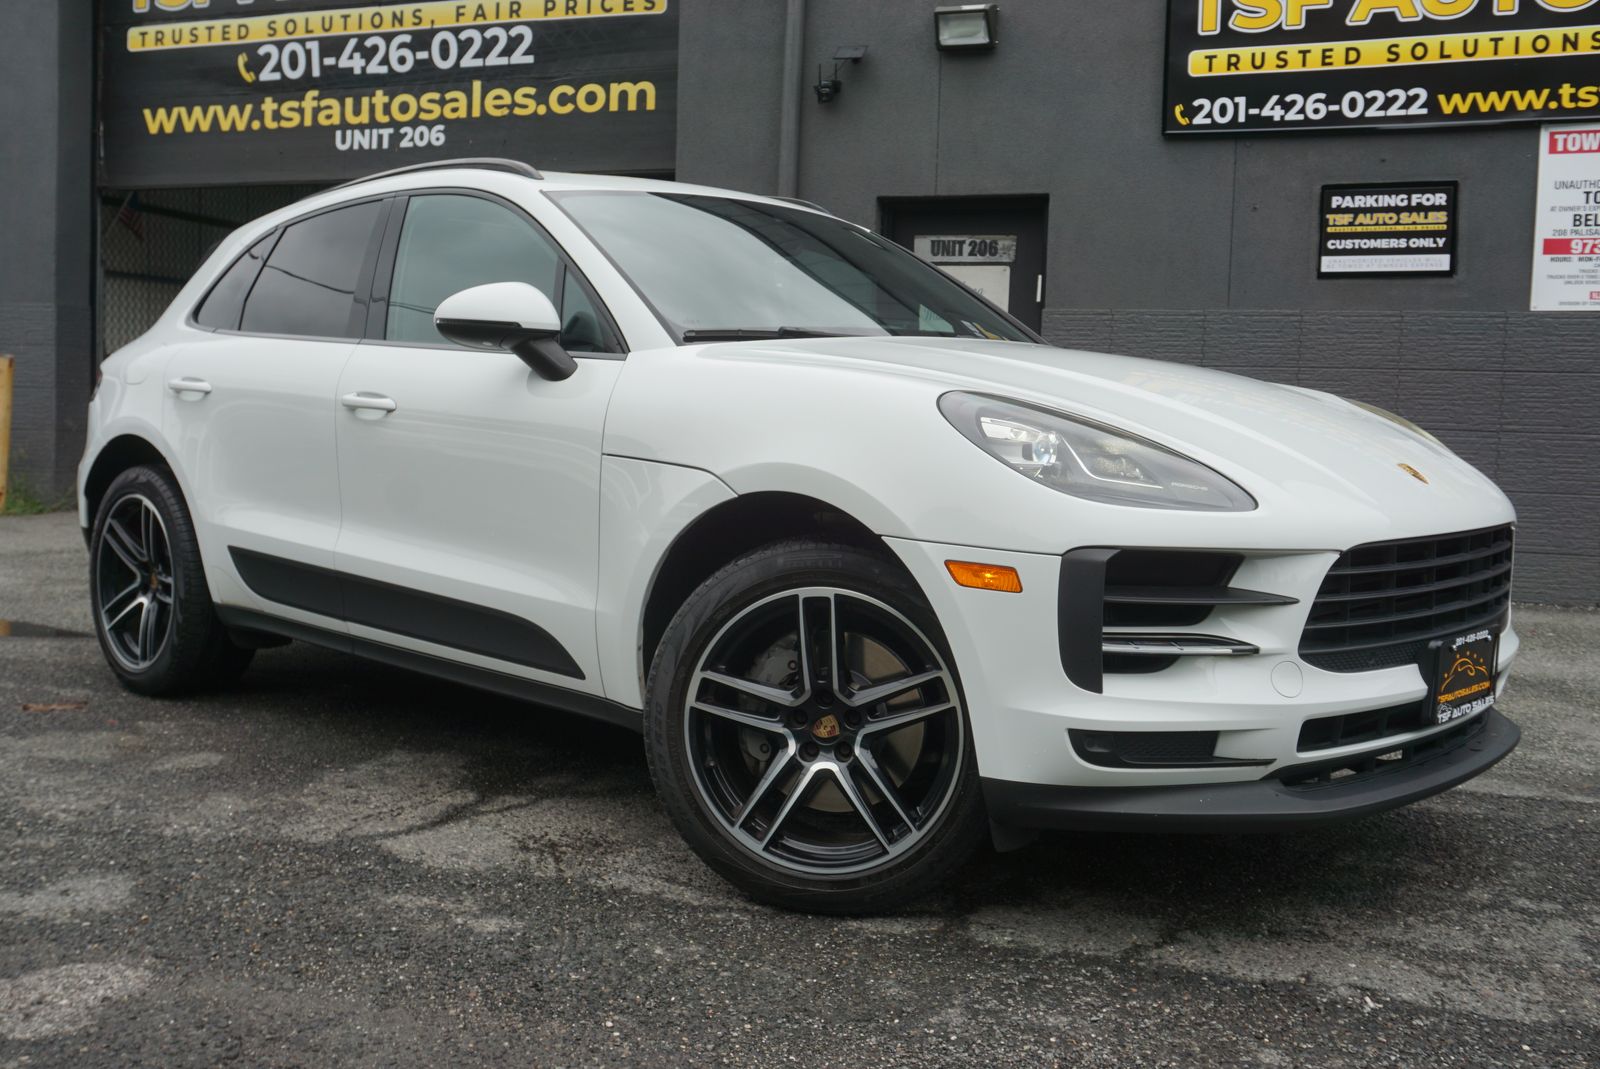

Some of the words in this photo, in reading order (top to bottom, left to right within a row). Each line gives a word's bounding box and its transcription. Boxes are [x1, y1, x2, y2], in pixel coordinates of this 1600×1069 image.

[139, 24, 249, 47] TRUSTED
[267, 8, 435, 37] SOLUTIONS,
[455, 1, 521, 23] FAIR
[544, 0, 656, 16] PRICES
[257, 25, 535, 82] 201-426-0222
[1205, 47, 1361, 72] TRUSTED
[1386, 30, 1600, 63] SOLUTIONS
[143, 80, 656, 135] www.tsfautosales.com
[1192, 87, 1428, 125] 201-426-0222
[1437, 83, 1600, 115] www.ts
[335, 128, 394, 151] UNIT
[399, 125, 446, 148] 206
[1331, 194, 1408, 208] PARKING
[1411, 193, 1447, 206] FOR
[1326, 213, 1354, 226] TSF
[1354, 212, 1398, 225] AUTO
[1398, 211, 1448, 224] SALES
[930, 239, 966, 257] UNIT
[967, 239, 999, 257] 206
[1327, 238, 1407, 249] CUSTOMERS
[1408, 237, 1446, 248] ONLY
[1437, 710, 1452, 724] TSF
[1452, 704, 1472, 718] AUTO
[1472, 695, 1494, 711] SALES
